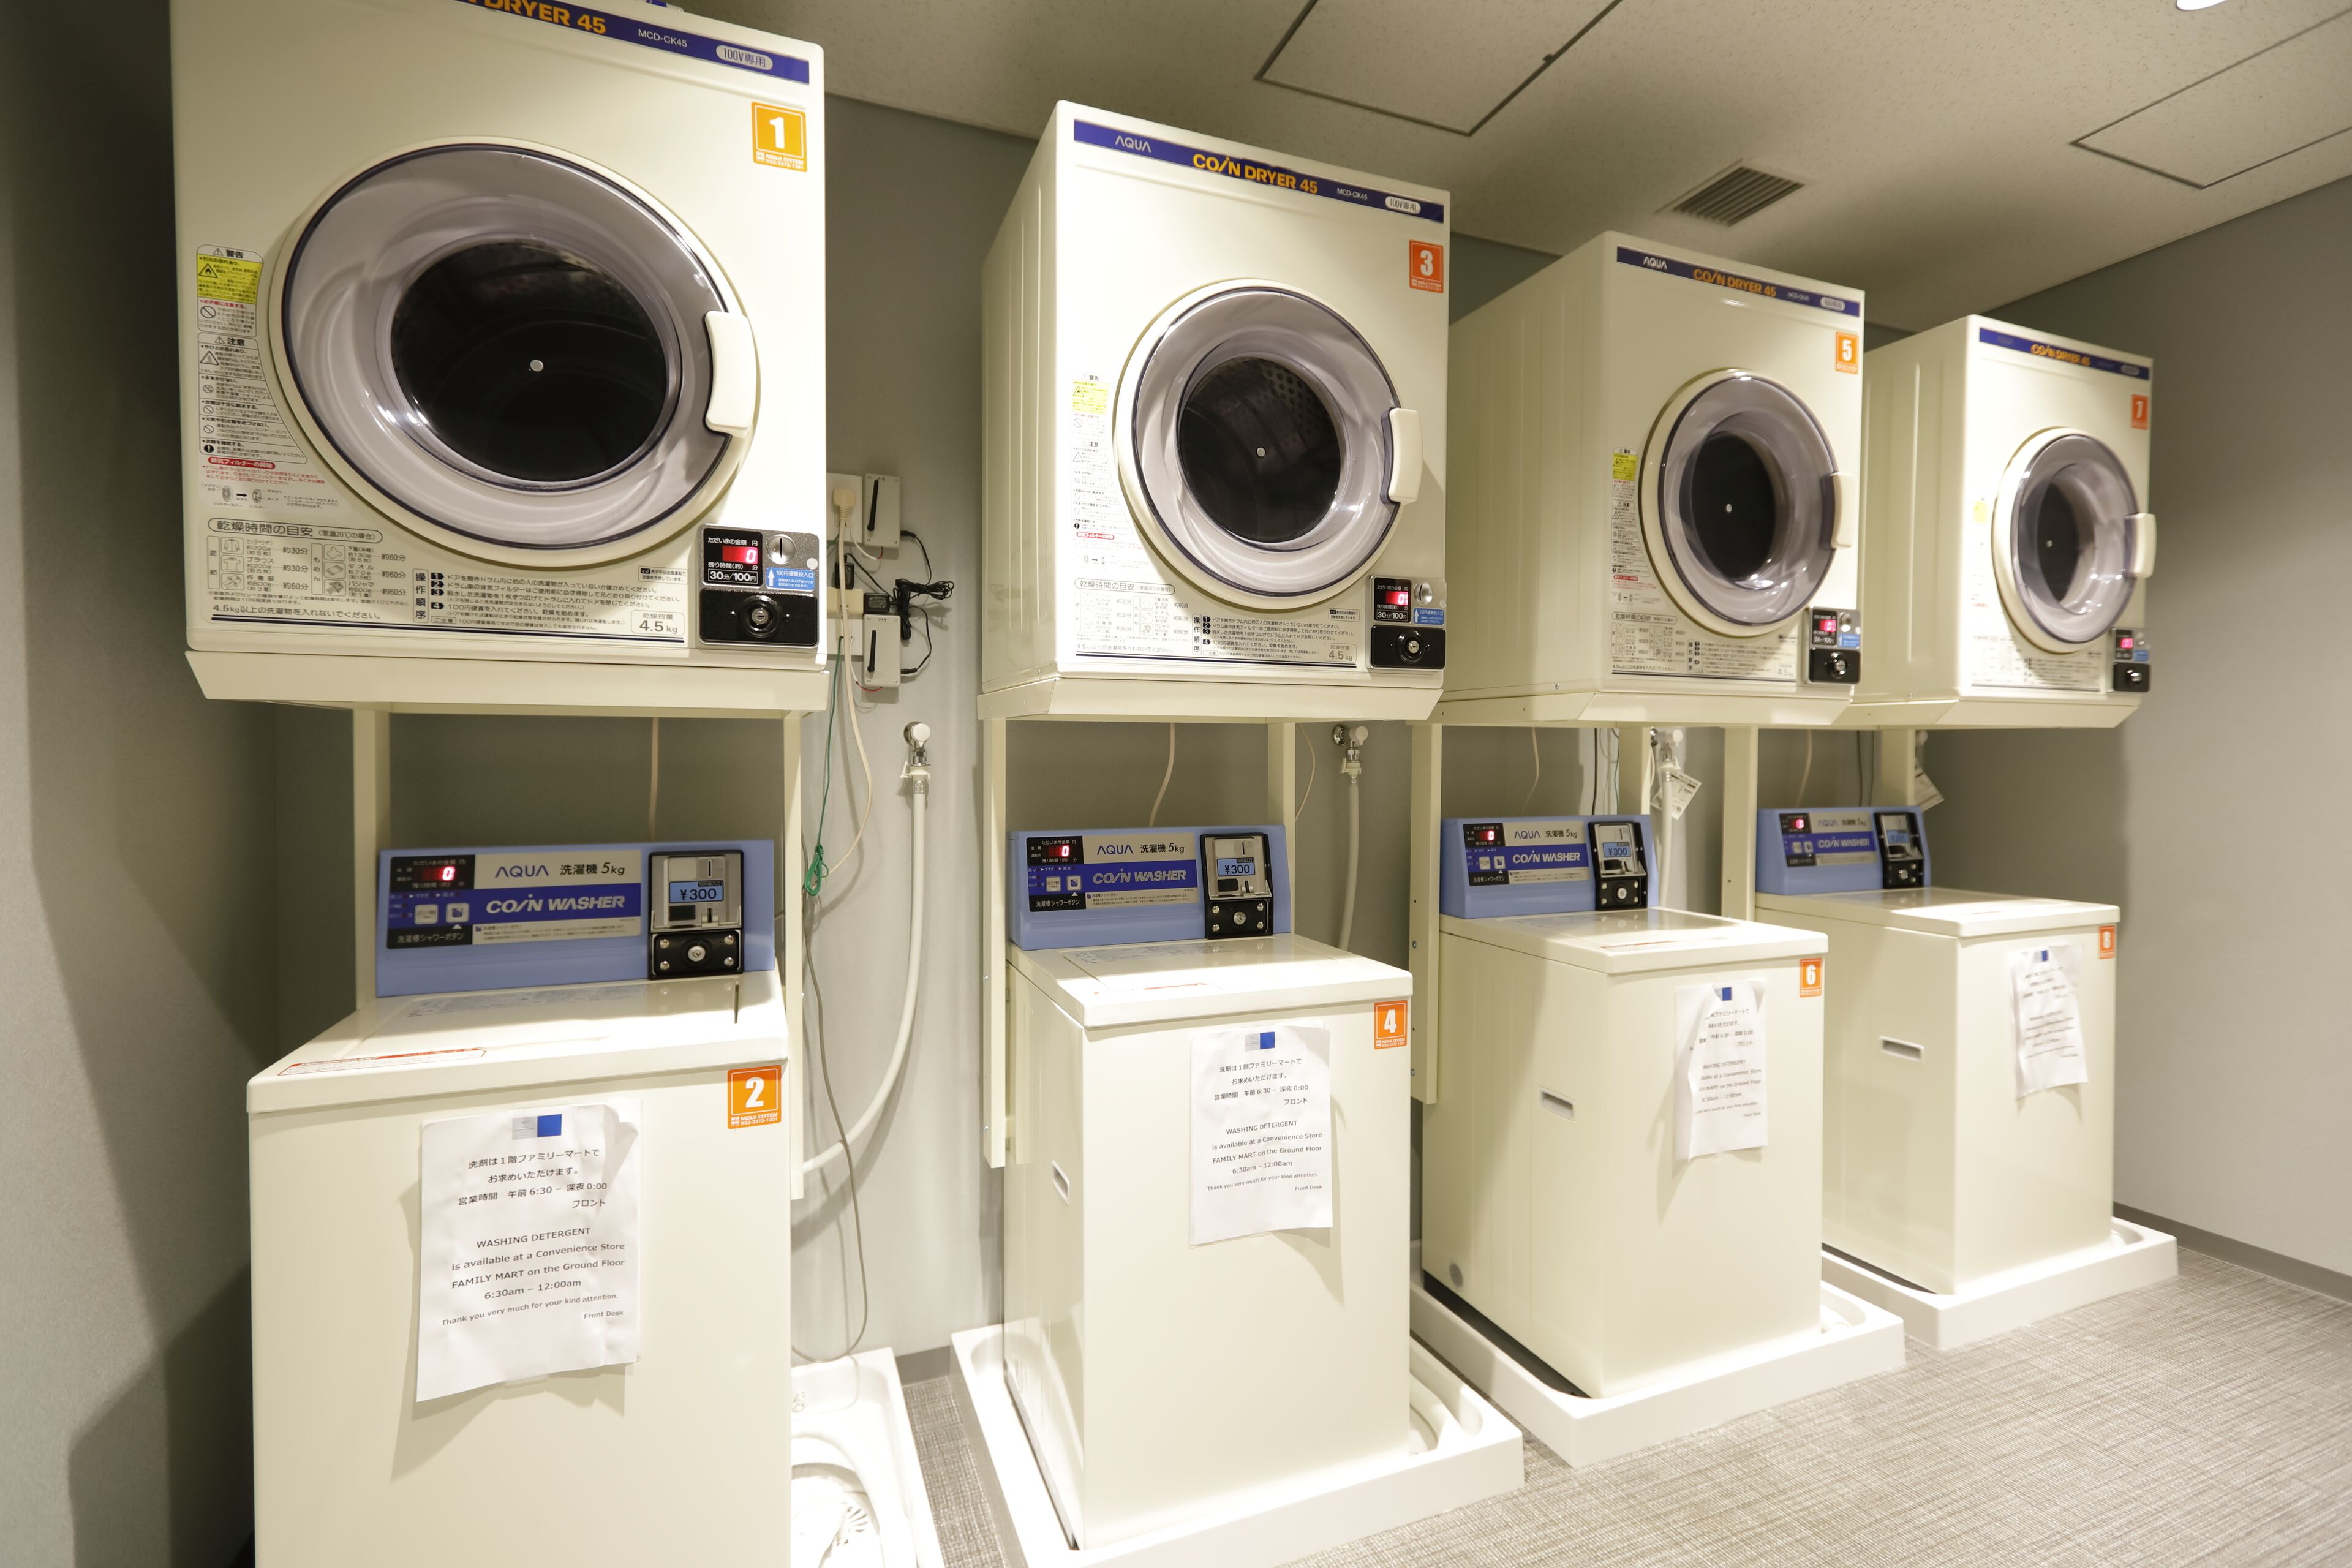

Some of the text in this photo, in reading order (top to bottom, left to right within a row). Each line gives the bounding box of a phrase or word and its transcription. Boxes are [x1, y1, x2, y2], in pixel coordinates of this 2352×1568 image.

[578, 14, 606, 34] 45
[638, 29, 687, 48] MCD-CK45
[723, 48, 766, 67] 100V専用
[769, 117, 784, 149] 1
[1115, 135, 1152, 153] AQUA
[1245, 165, 1297, 189] DRYER
[1300, 179, 1317, 194] 45
[1337, 187, 1368, 200] MCD-CK45
[1390, 198, 1417, 212] 100V専用
[226, 249, 243, 258] 警告
[1420, 249, 1433, 276] 3
[1643, 256, 1667, 270] AQUA
[1727, 276, 1762, 294] DRYER
[1763, 285, 1776, 298] 45
[227, 337, 244, 346] 注意
[1842, 339, 1852, 361] 5
[217, 521, 313, 537] 乾燥時間の目安
[745, 549, 757, 563] 0
[710, 571, 756, 582] 30分/100円
[1079, 580, 1135, 591] 乾燥時間の目安
[213, 605, 381, 620] 4.5kg以上の洗濯物を入れないでください。
[639, 620, 677, 634] 4.5 kg
[1329, 650, 1344, 660] 4.5
[1488, 831, 1494, 840] 0
[1514, 828, 1578, 839] AQUA 洗濯機 5kg
[1062, 845, 1069, 857] 0
[1096, 842, 1185, 855] AQUA 洗濯機 5kg
[1608, 847, 1627, 856] ¥300
[1543, 853, 1580, 862] WASHER
[442, 866, 455, 881] 0
[495, 862, 625, 878] AQUA 洗濯機 5kg
[1134, 870, 1186, 882] WASHER
[1225, 864, 1250, 875] ¥300
[679, 888, 717, 901] ¥300
[548, 895, 625, 910] WASHER
[1807, 964, 1816, 985] 6
[1384, 1009, 1397, 1033] 4
[1219, 1058, 1302, 1073] 洗剤は1階ファミリーマートで
[1231, 1072, 1287, 1085] お求めいただけます。
[745, 1077, 764, 1108] 2
[1215, 1091, 1238, 1101] 営業時間
[1226, 1120, 1298, 1134] WASHING DETERGENT
[1219, 1140, 1247, 1150] available
[1262, 1133, 1303, 1142] Convenience
[468, 1148, 600, 1170] 洗剤は1階ファミリーマートで
[1213, 1155, 1236, 1164] FAMILY
[488, 1167, 579, 1184] お求めいただけます。
[1232, 1166, 1256, 1174] 6:30am
[458, 1182, 607, 1207] 営業時間 午前 6:30 深夜 0:00
[572, 1199, 606, 1208] フロント
[477, 1227, 591, 1248] WASHING DETERGENT
[464, 1255, 510, 1269] available
[513, 1253, 524, 1261] at
[536, 1244, 598, 1258] Convenience
[600, 1243, 625, 1251] Store
[451, 1274, 491, 1289] FAMILY
[495, 1270, 524, 1281] MART
[543, 1264, 560, 1273] the
[564, 1261, 598, 1271] Ground
[601, 1259, 625, 1267] Floor
[484, 1279, 581, 1300] 6:30am 12:00am
[441, 1316, 467, 1327] Thank
[470, 1312, 484, 1321] you
[487, 1308, 505, 1317] very
[508, 1305, 529, 1313] much
[545, 1298, 562, 1308] your
[564, 1296, 581, 1305] kind
[582, 1294, 619, 1303] attention.
[584, 1310, 604, 1319] Front
